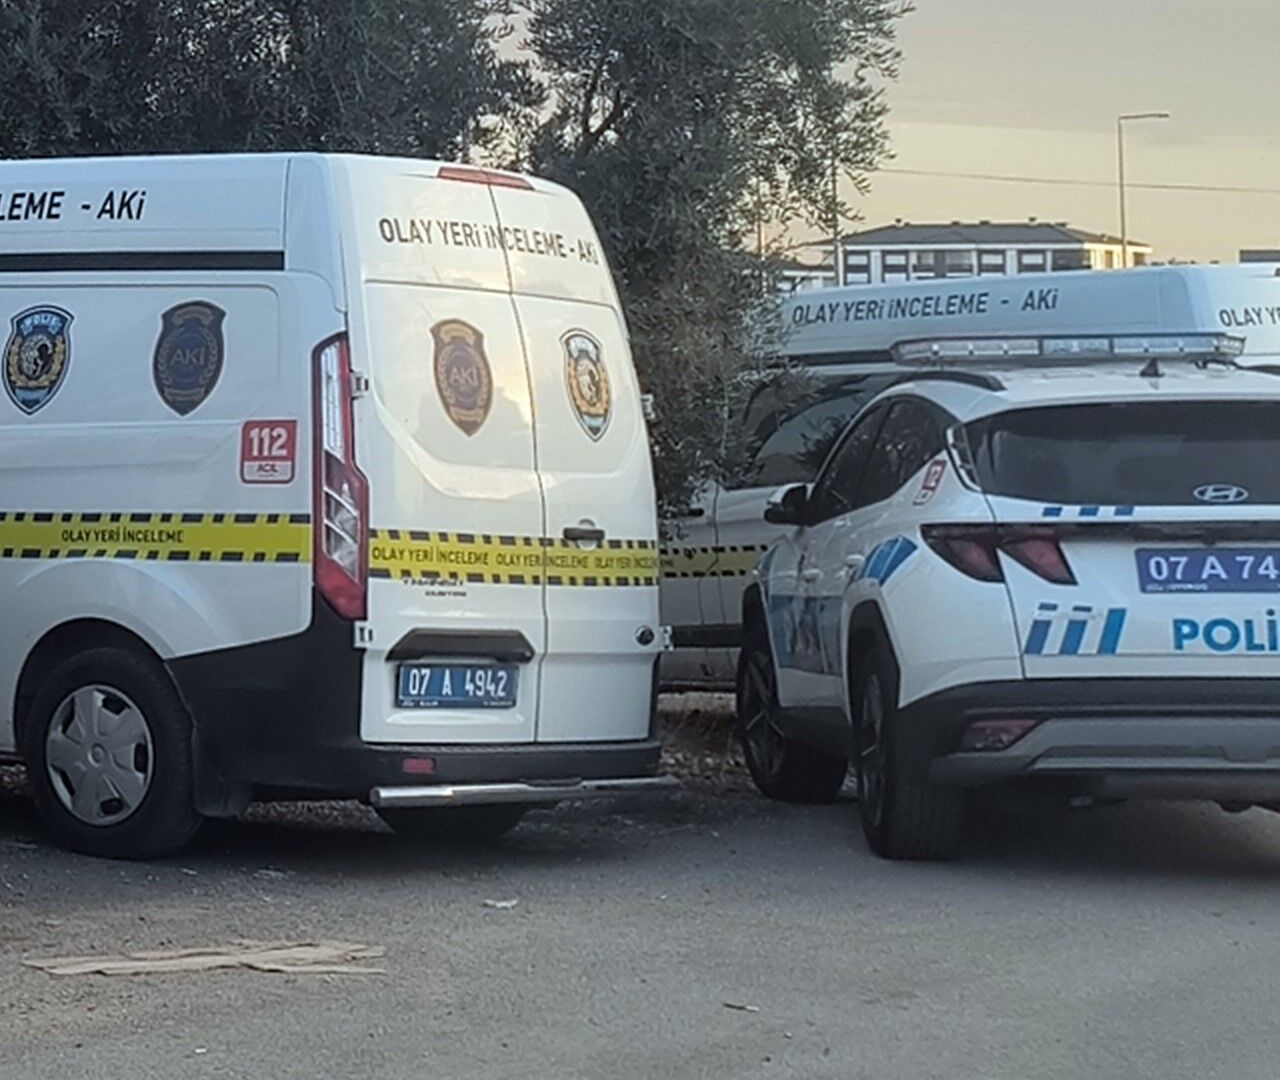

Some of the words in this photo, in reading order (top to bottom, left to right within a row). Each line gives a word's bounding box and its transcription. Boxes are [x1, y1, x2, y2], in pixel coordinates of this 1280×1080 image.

[379, 218, 433, 244] OLAY
[791, 302, 839, 325] OLAY
[1219, 307, 1263, 327] OLAY
[250, 427, 288, 457] 112
[61, 529, 91, 542] OLAY
[372, 547, 406, 561] OLAY
[496, 552, 520, 566] OLAY
[1148, 556, 1188, 580] 07
[1201, 555, 1228, 580] A
[1235, 555, 1279, 580] 74
[408, 668, 431, 695] 07
[442, 668, 452, 696] A
[465, 669, 507, 697] 4942
